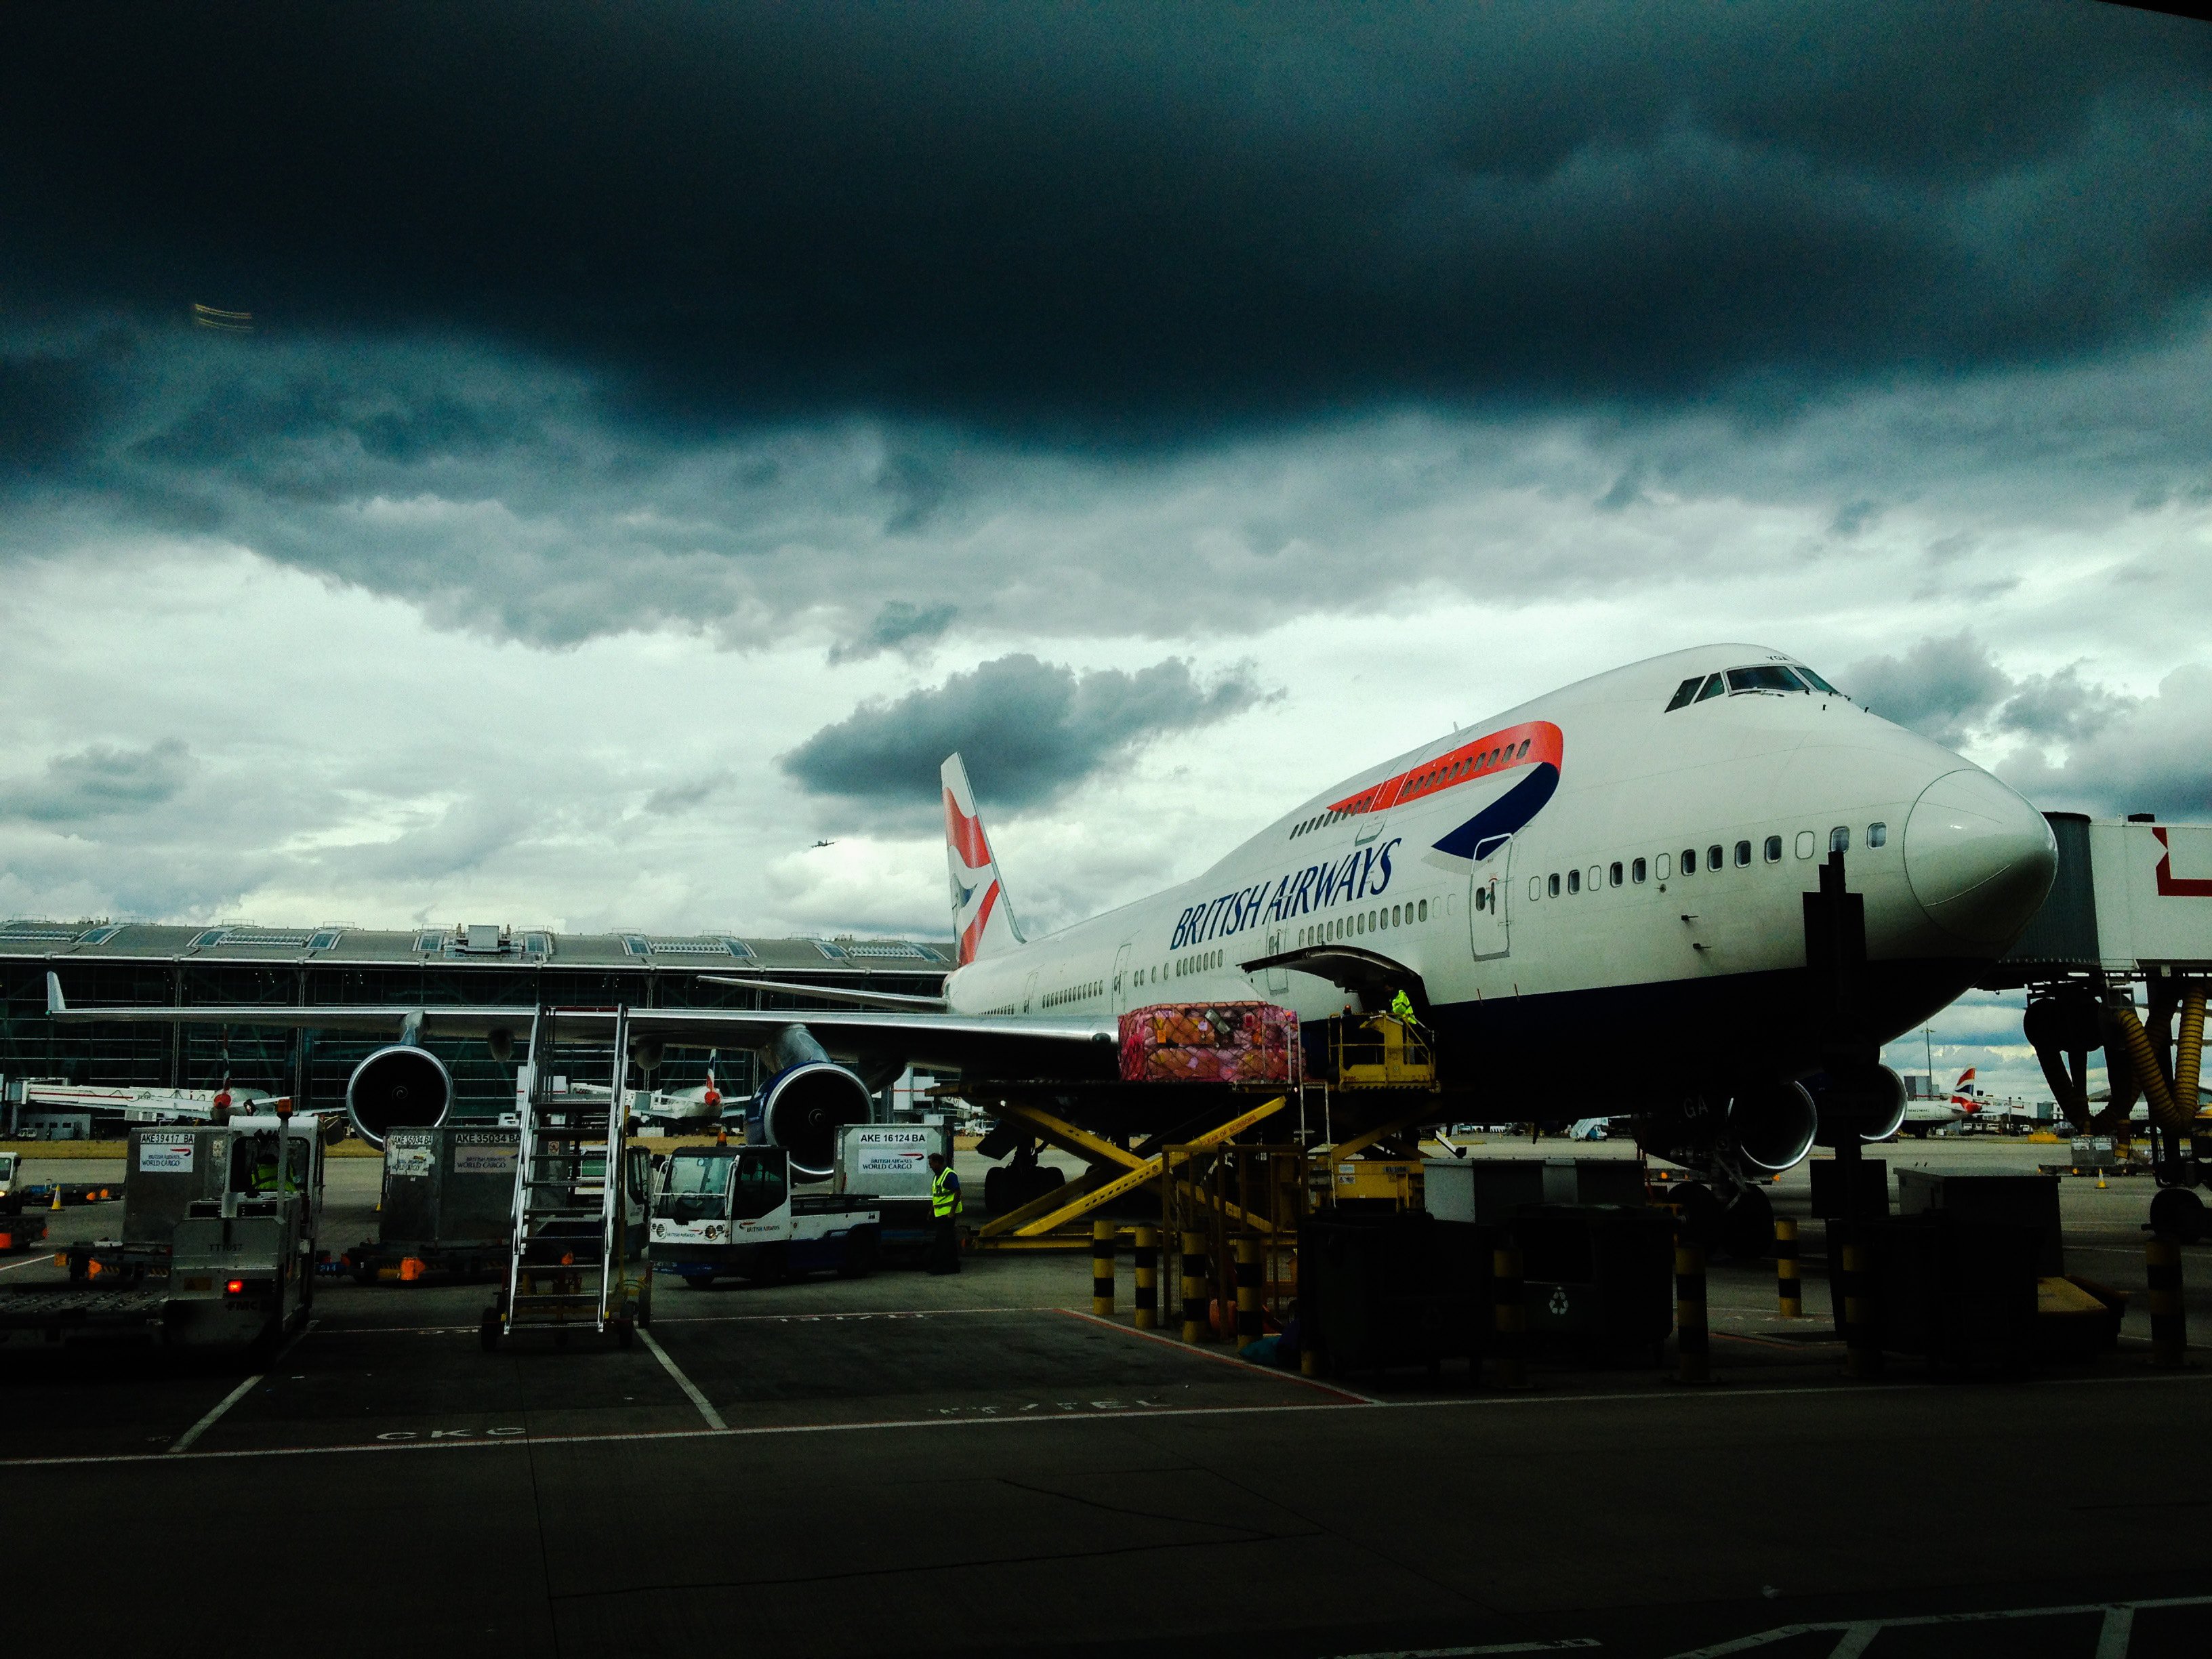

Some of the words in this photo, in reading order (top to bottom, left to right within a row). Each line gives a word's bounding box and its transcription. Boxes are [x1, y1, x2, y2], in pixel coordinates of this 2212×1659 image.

[1169, 881, 1271, 951] BRITISH
[1261, 838, 1402, 925] AIRWAYS
[184, 1134, 193, 1143] BA
[457, 1134, 475, 1143] AKE
[476, 1134, 507, 1143] 35034
[860, 1134, 881, 1142] AKE
[912, 1134, 926, 1142] BA
